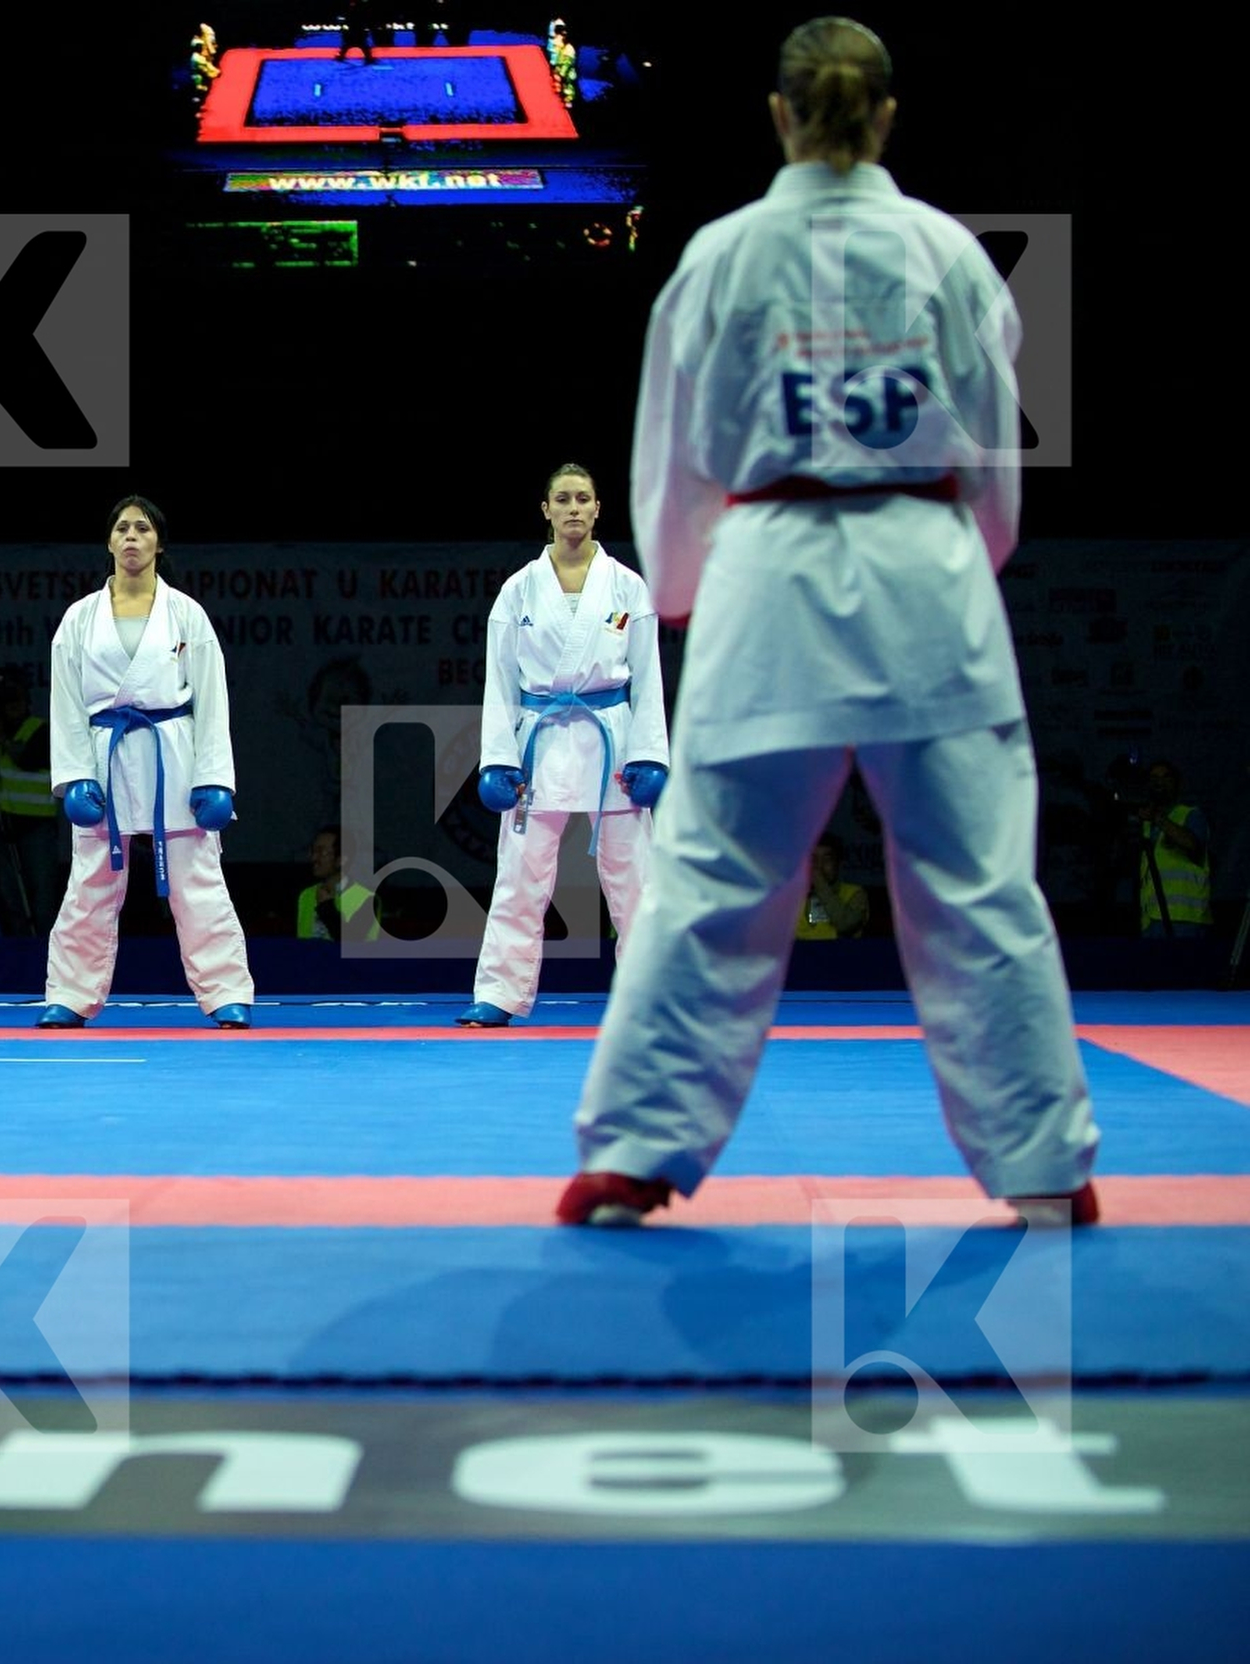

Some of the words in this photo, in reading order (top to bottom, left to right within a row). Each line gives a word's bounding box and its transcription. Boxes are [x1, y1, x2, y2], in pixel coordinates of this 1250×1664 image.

[780, 367, 930, 436] ESP
[338, 569, 359, 599] U
[380, 569, 508, 599] KARATE
[215, 614, 293, 646] NIOR
[313, 614, 432, 646] KARATE
